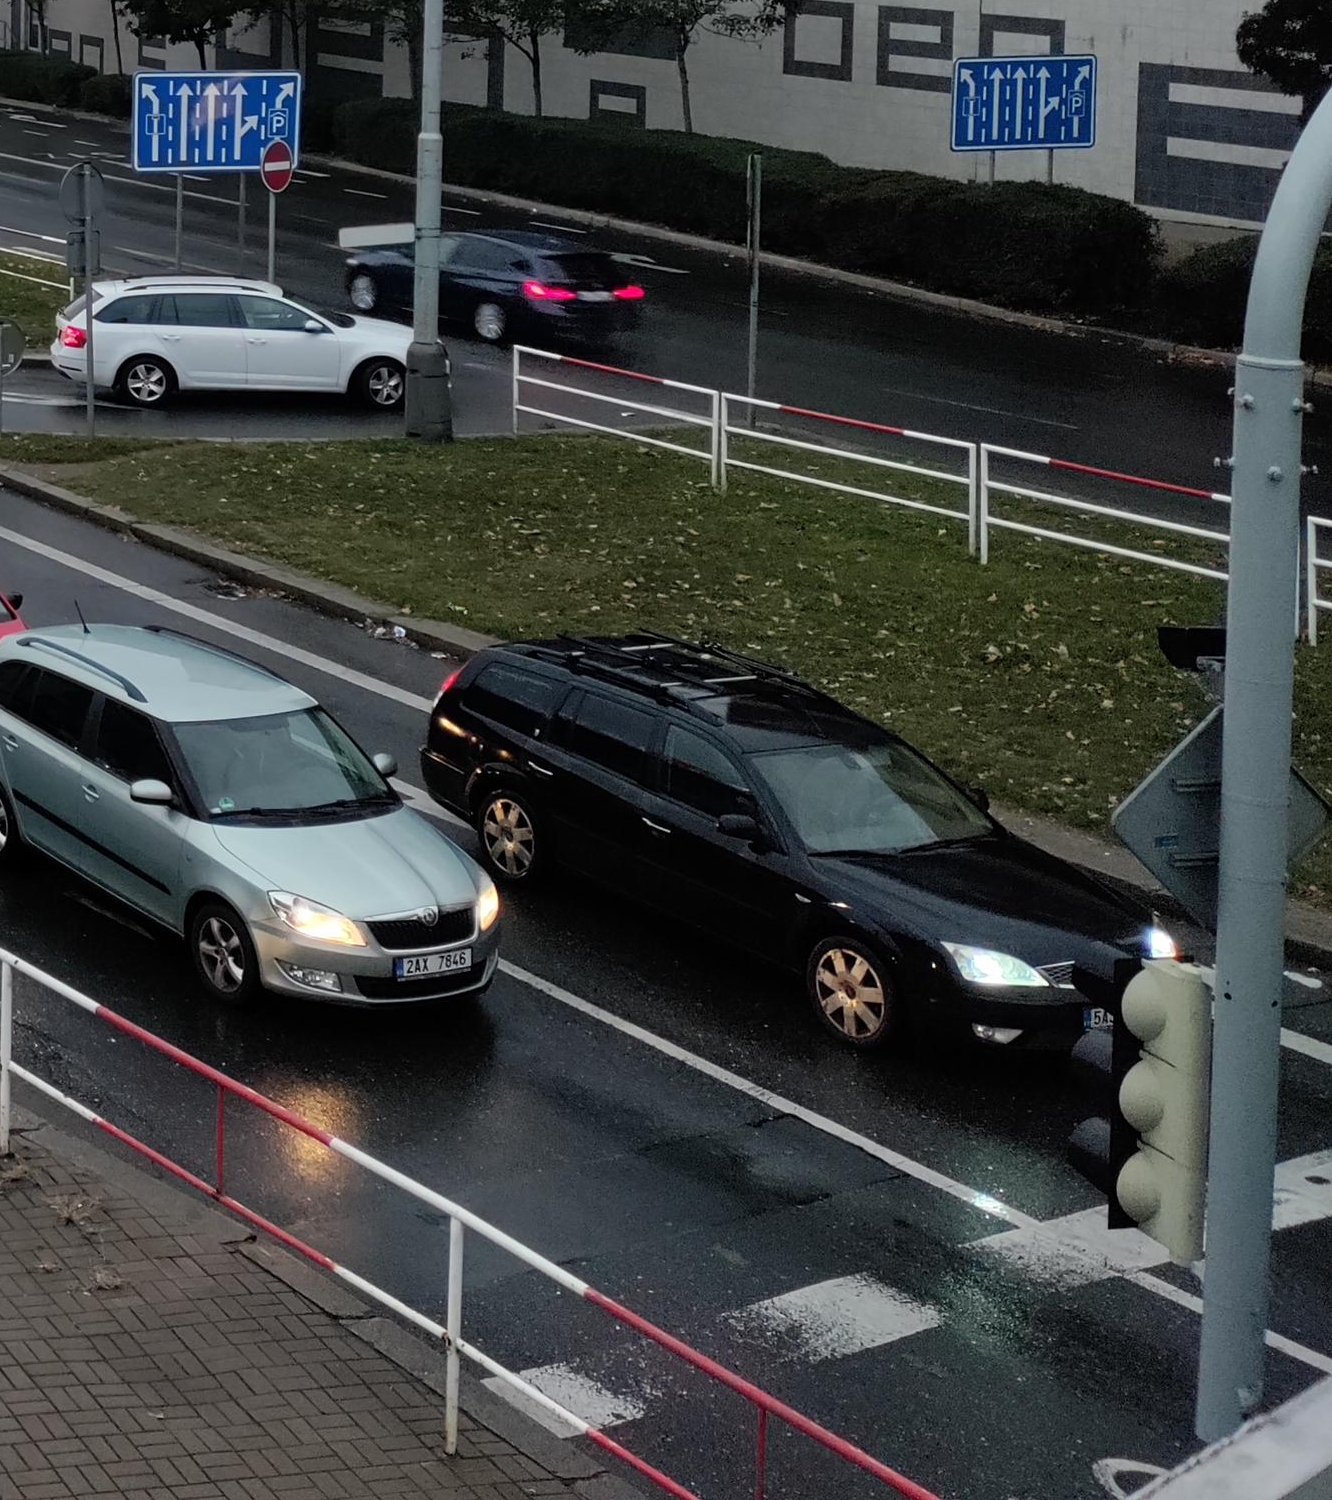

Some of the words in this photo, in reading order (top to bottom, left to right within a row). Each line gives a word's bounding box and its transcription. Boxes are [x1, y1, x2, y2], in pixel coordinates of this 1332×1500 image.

[1072, 97, 1082, 113] P
[273, 116, 285, 133] P
[406, 958, 429, 974] 2AX
[438, 952, 467, 970] 7846
